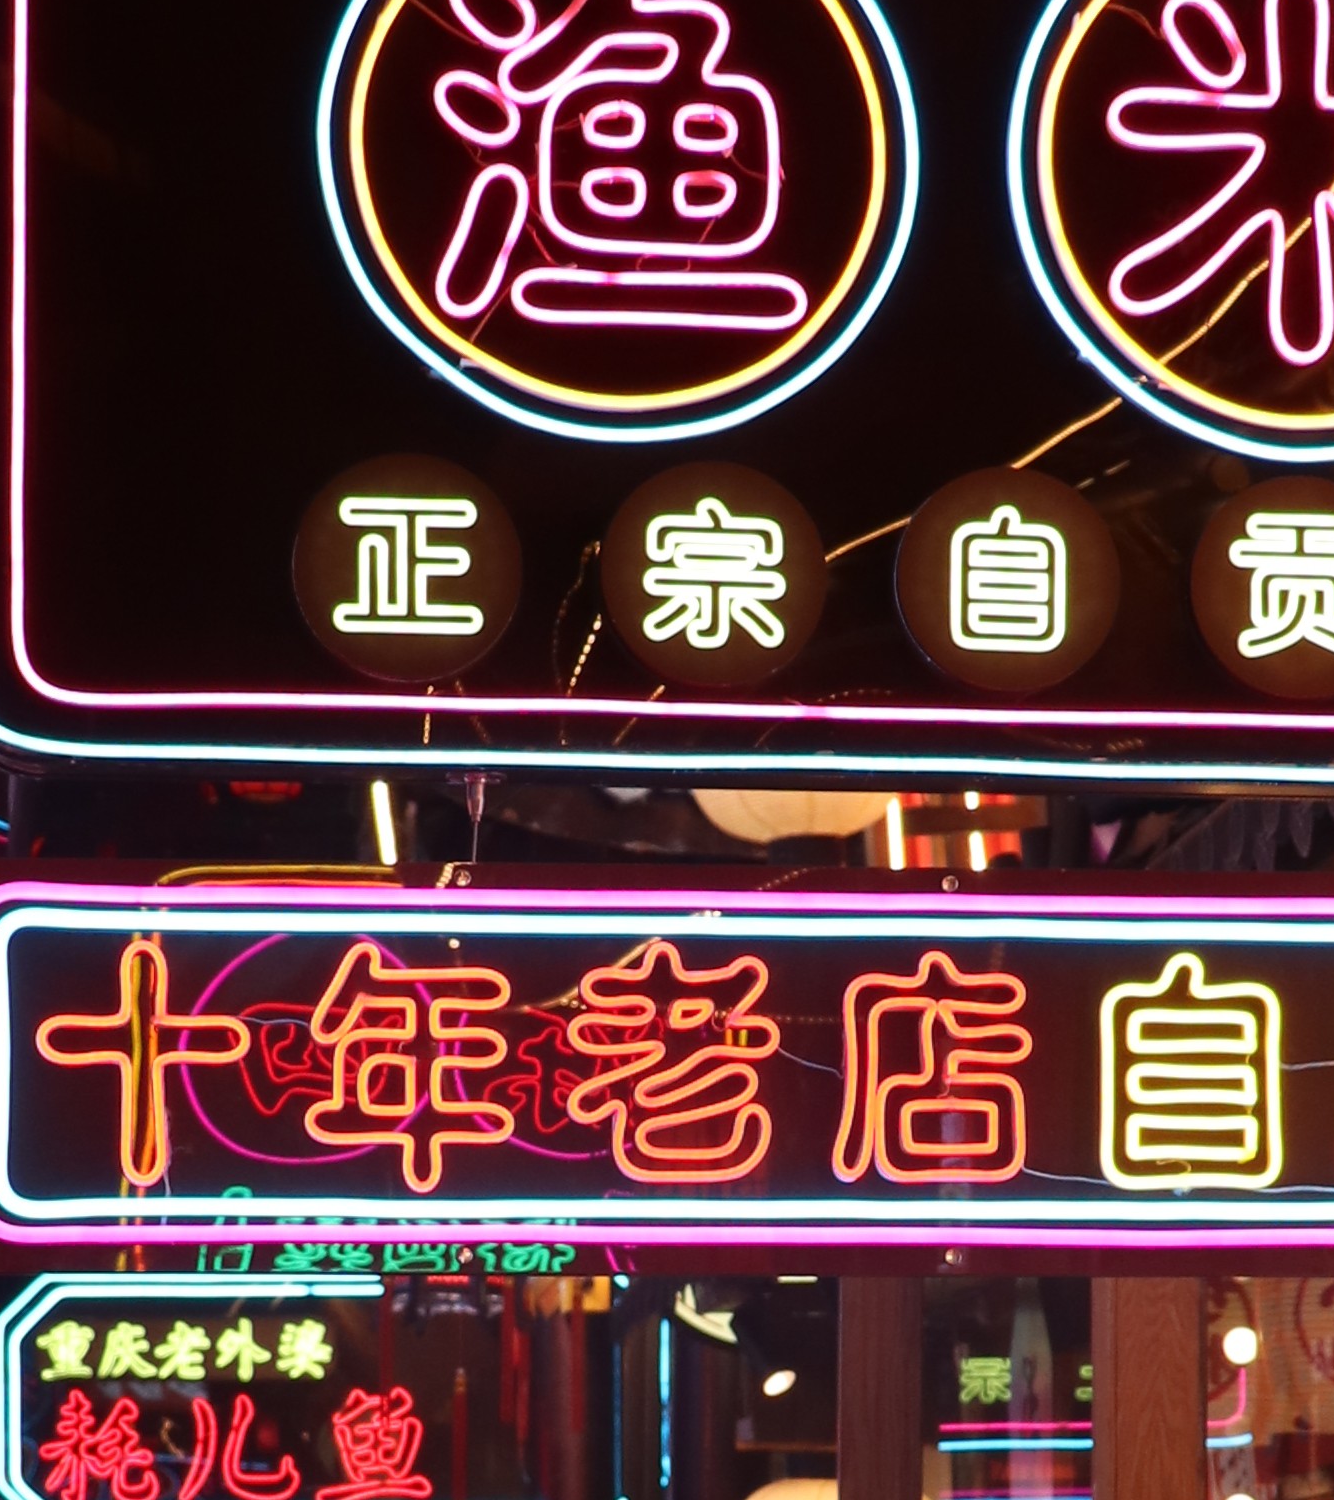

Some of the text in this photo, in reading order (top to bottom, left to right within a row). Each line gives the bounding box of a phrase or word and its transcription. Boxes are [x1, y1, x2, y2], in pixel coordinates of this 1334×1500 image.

[36, 1316, 333, 1383] 重庆老外婆
